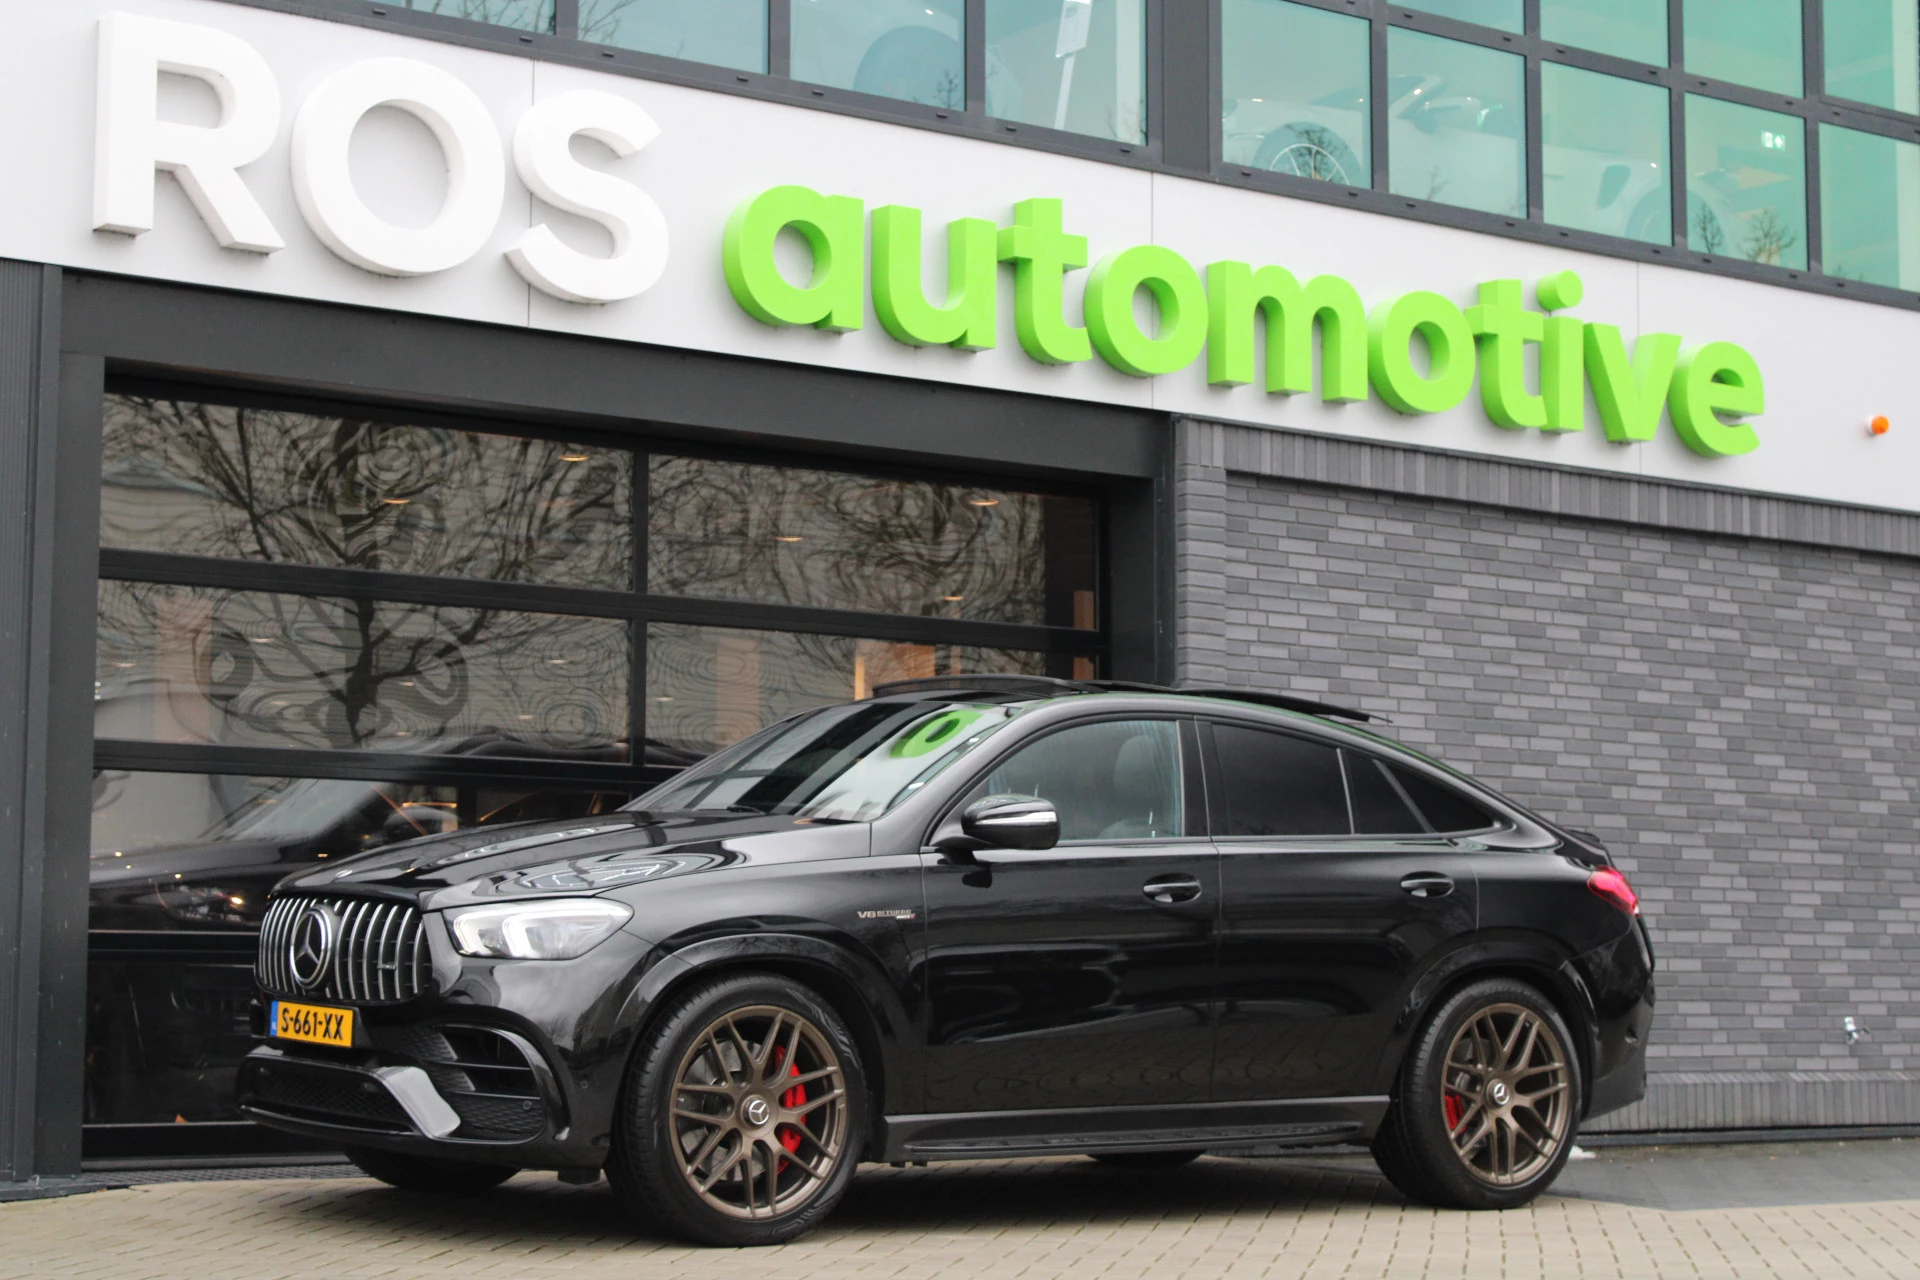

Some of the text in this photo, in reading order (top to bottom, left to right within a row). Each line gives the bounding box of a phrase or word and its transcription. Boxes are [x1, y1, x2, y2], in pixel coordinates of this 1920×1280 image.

[94, 12, 1764, 458] ROS automotive
[857, 910, 877, 919] V8
[281, 1007, 344, 1040] S-661-XX
